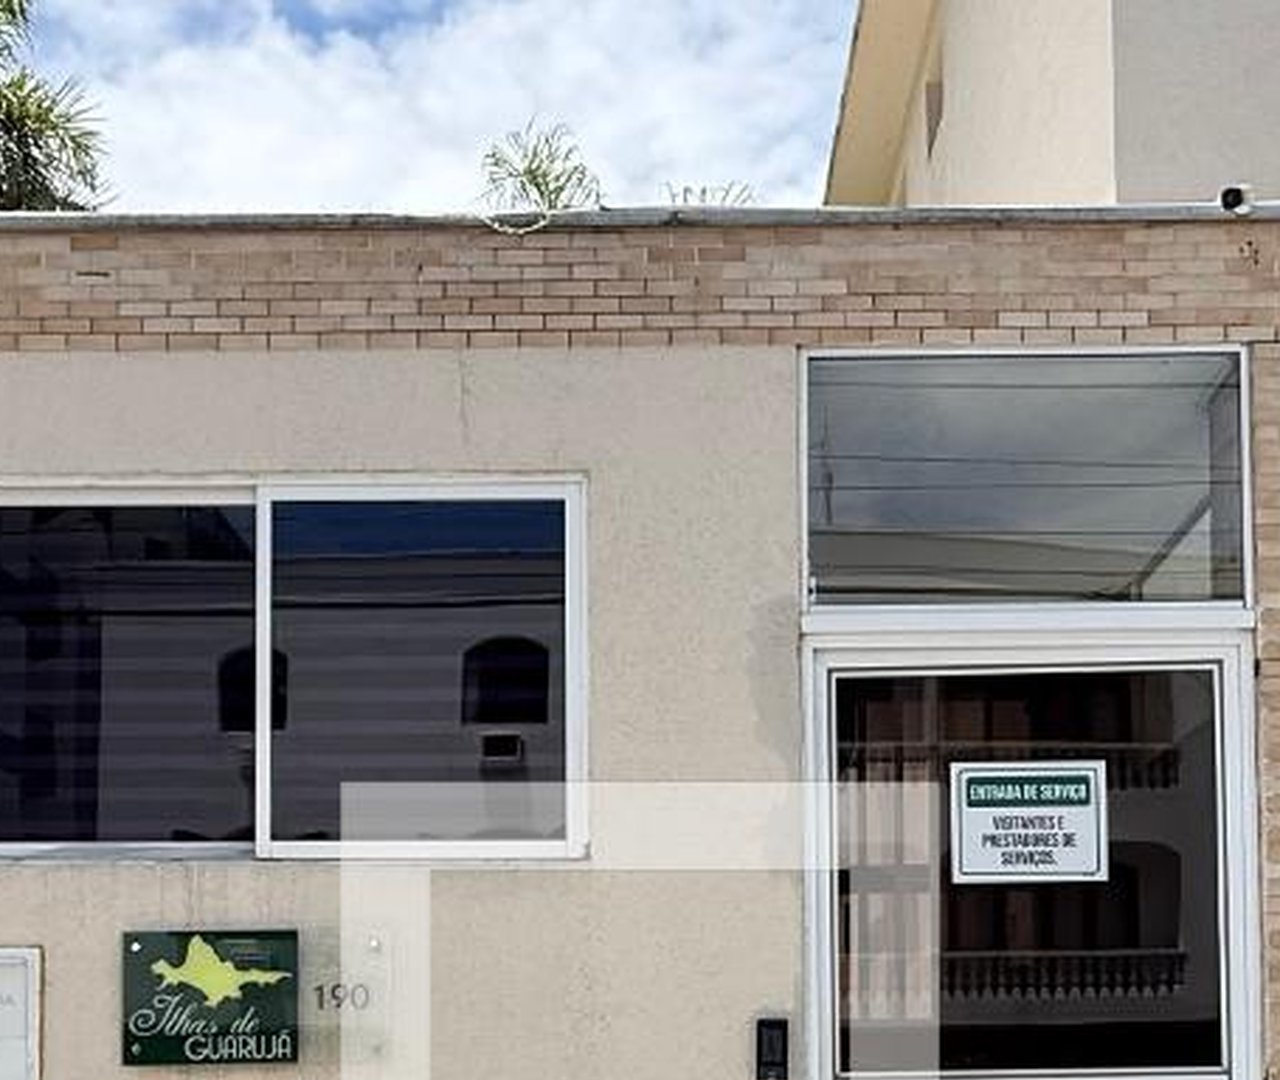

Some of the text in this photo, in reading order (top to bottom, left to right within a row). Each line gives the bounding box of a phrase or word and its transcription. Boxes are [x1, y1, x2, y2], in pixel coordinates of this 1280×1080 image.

[970, 784, 1087, 800] ENTRADA DE SERVIÇO
[992, 815, 1065, 831] VISITANTES E
[981, 832, 1077, 848] PRESTADORES DE
[314, 984, 370, 1010] 190
[230, 1006, 261, 1034] de
[184, 1029, 293, 1062] GUARUJÁ
